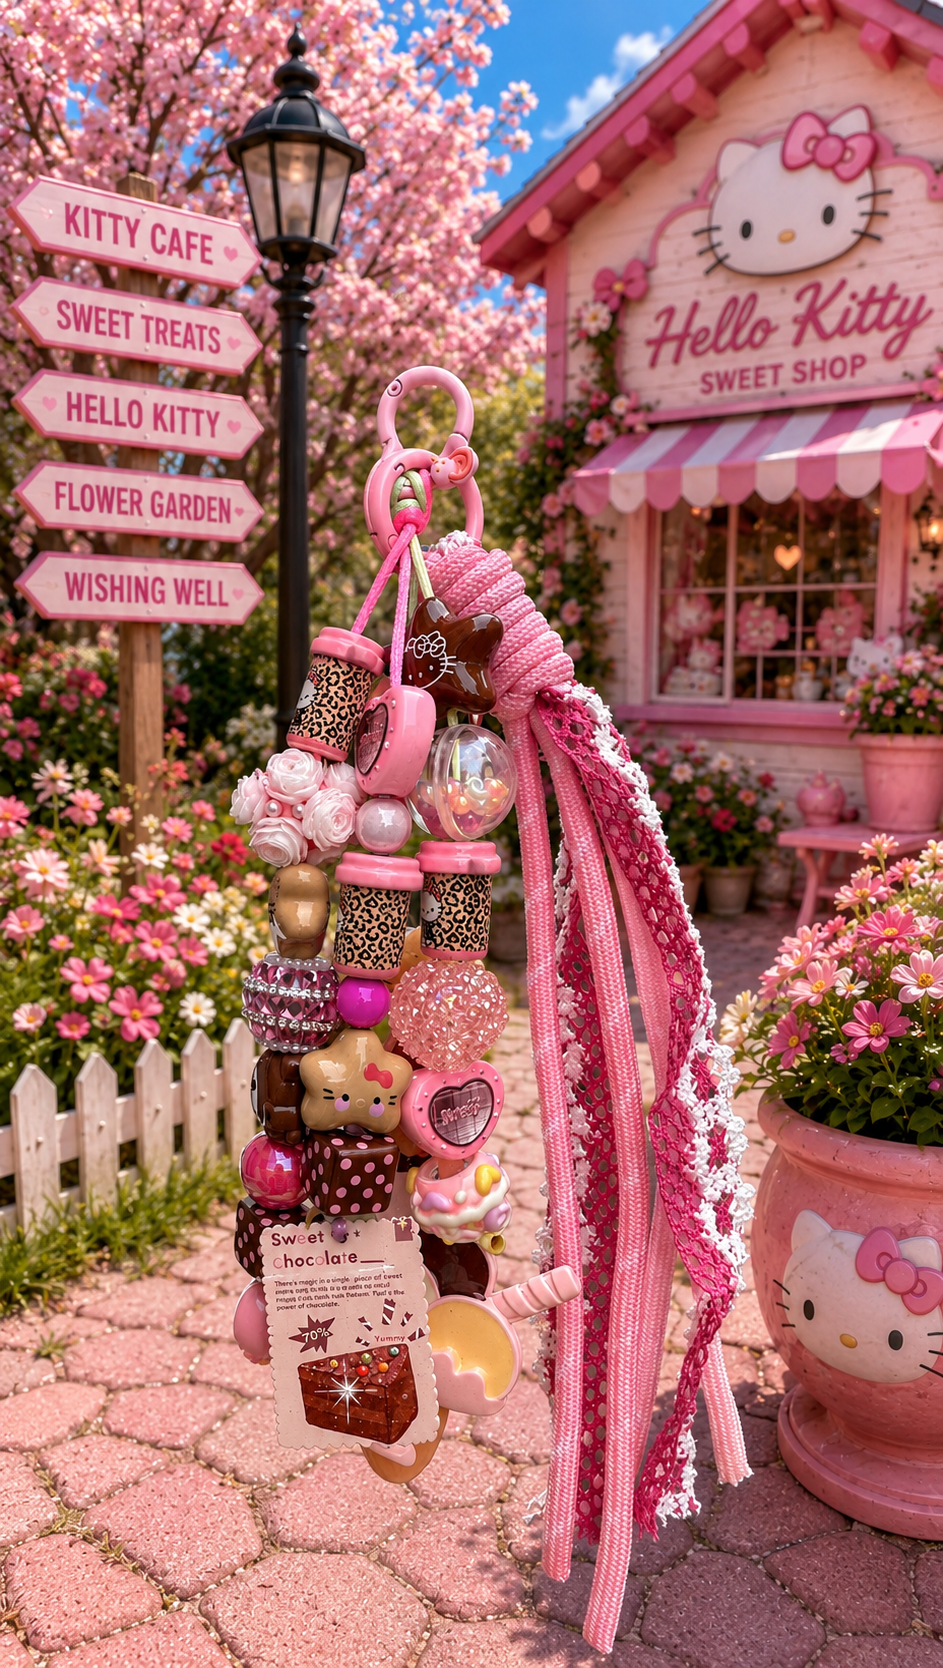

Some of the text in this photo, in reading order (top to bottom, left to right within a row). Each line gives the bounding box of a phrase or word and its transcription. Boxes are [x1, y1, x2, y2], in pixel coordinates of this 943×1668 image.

[64, 202, 214, 266] KITTY CAFE
[56, 299, 221, 355] SWEET TREATS
[645, 278, 934, 369] Hello Kitty
[700, 353, 867, 395] SWEET SHOP
[66, 391, 221, 438] HELLO KITTY
[54, 481, 232, 524] FLOWER GARDEN
[64, 571, 229, 607] WISHING WELL
[271, 1230, 325, 1247] Sweet
[272, 1250, 358, 1269] chocolate
[302, 1327, 330, 1342] 70%
[374, 1335, 406, 1343] Yummy
